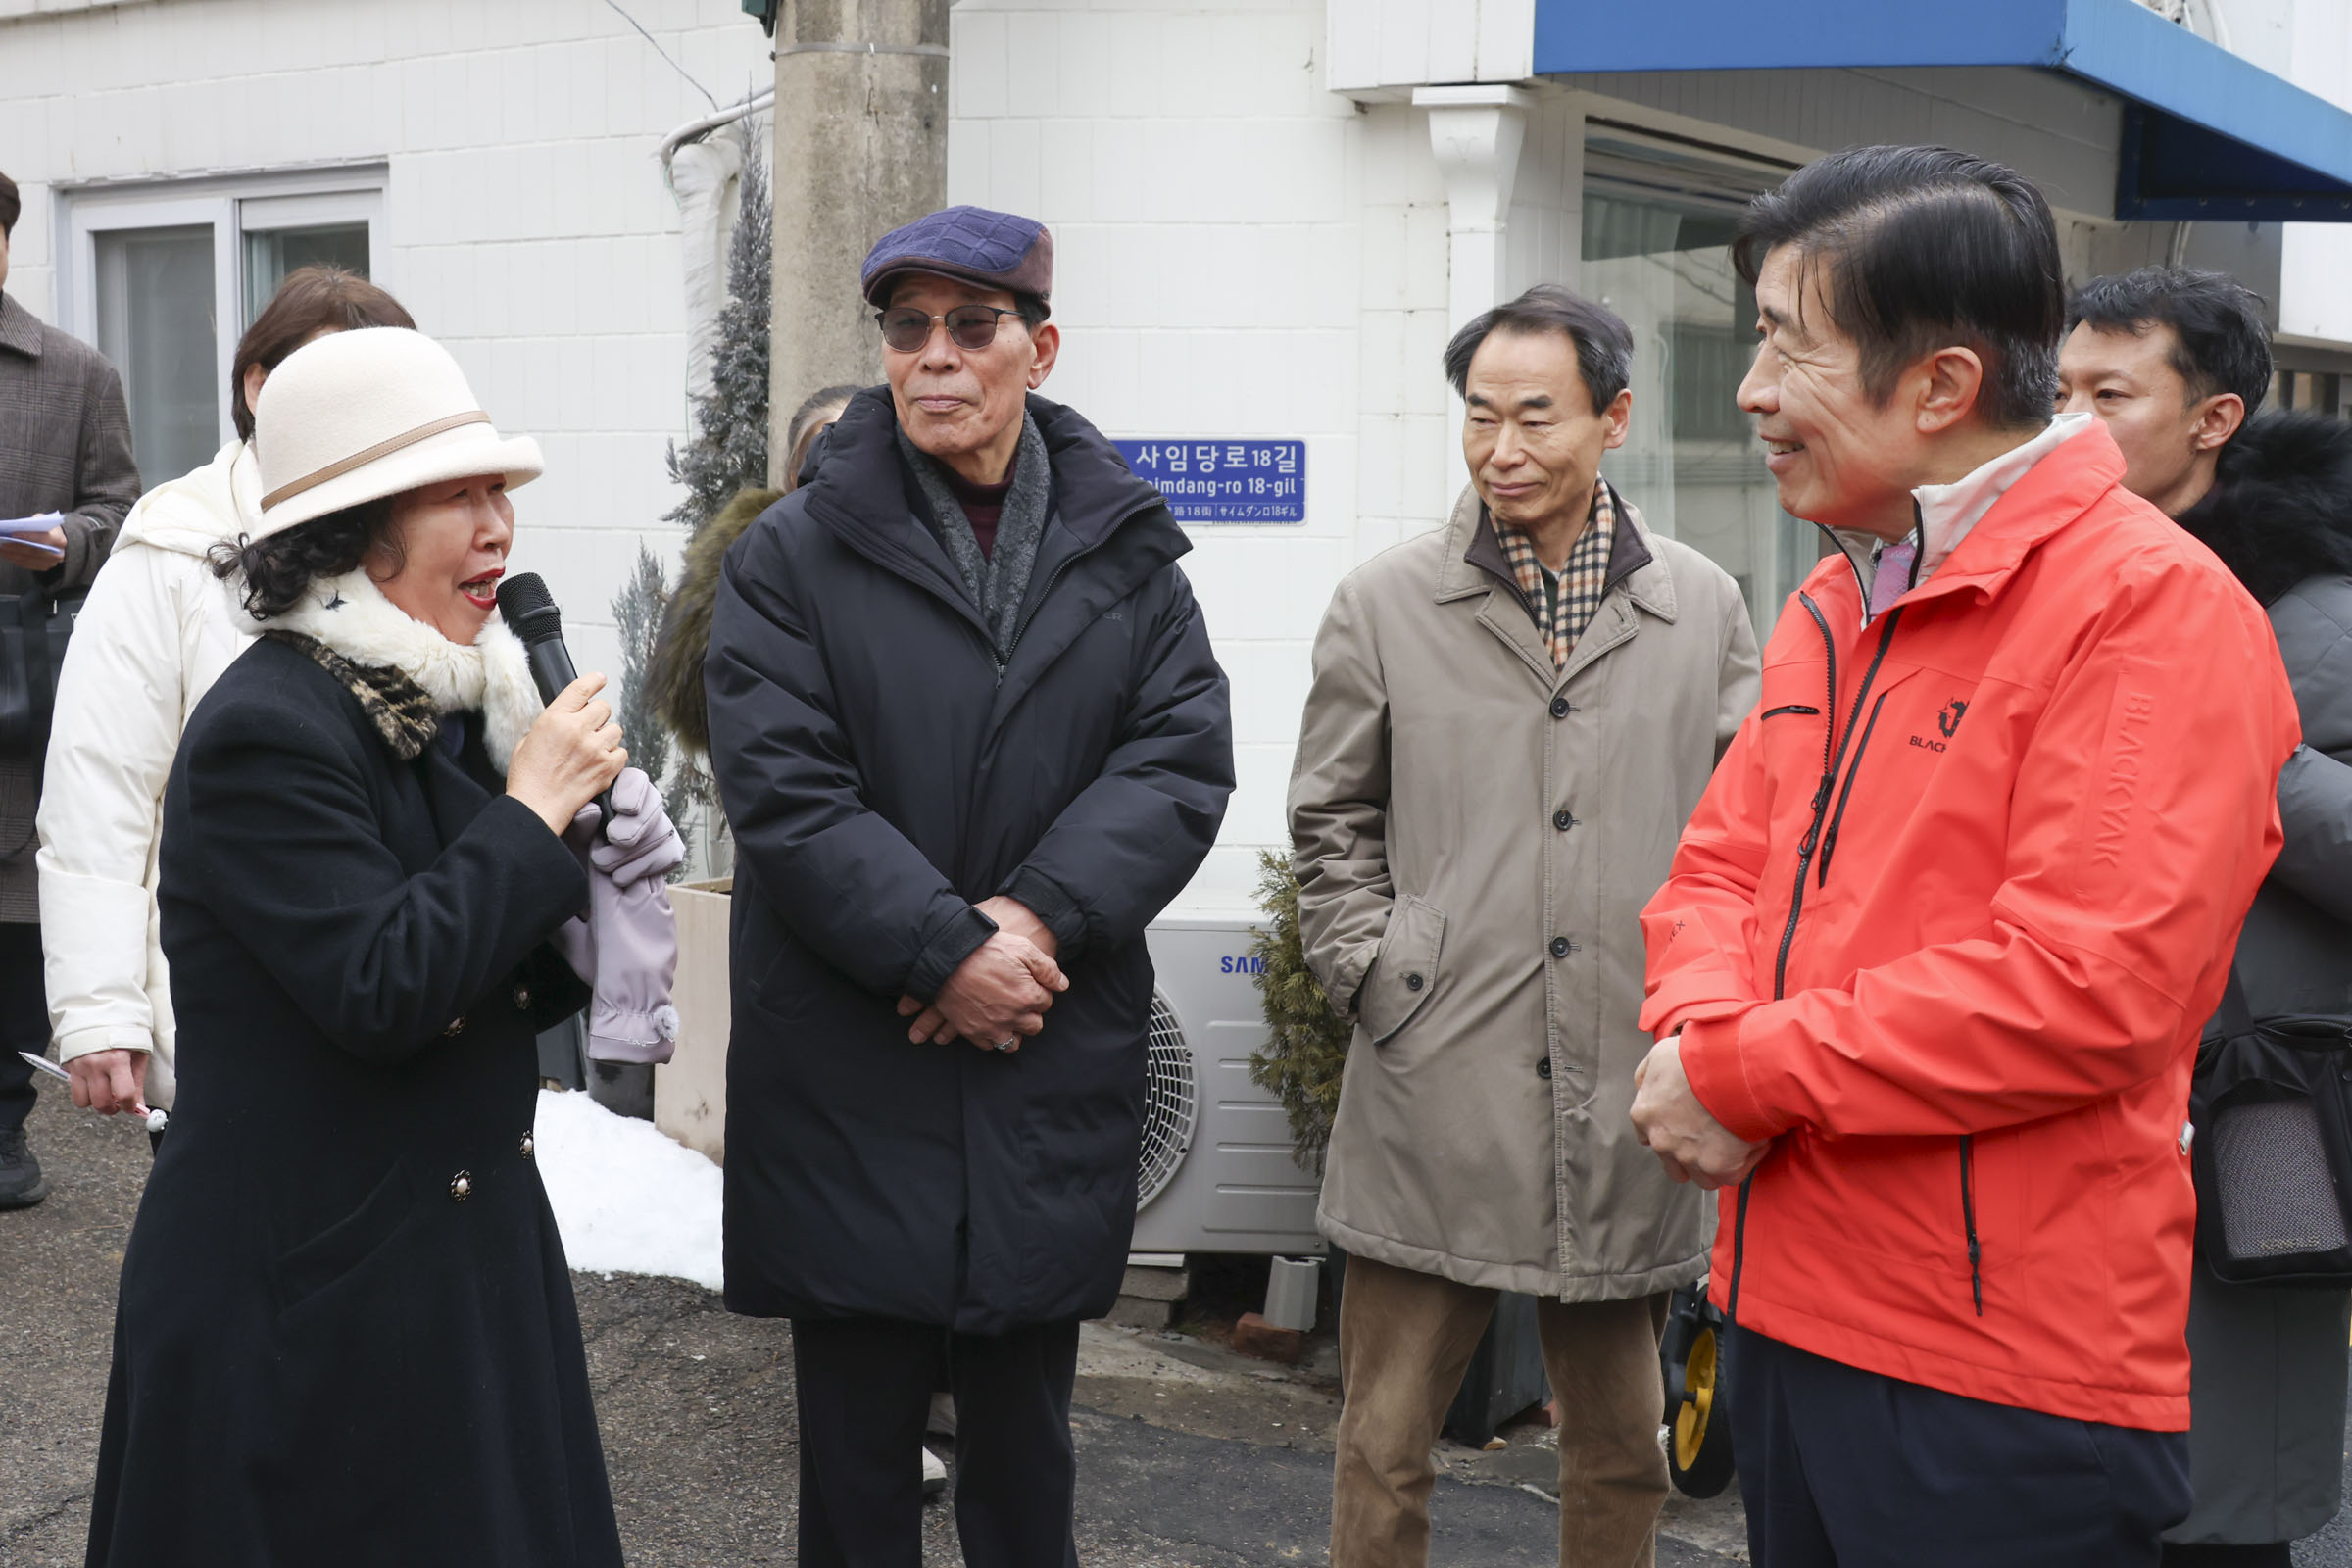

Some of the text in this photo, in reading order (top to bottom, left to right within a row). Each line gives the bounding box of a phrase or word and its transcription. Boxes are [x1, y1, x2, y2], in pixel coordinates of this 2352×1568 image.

[1138, 477, 1296, 497] imdang-ro 18-gil
[1168, 506, 1212, 517] 路18街
[2091, 691, 2154, 869] BLACKYAK
